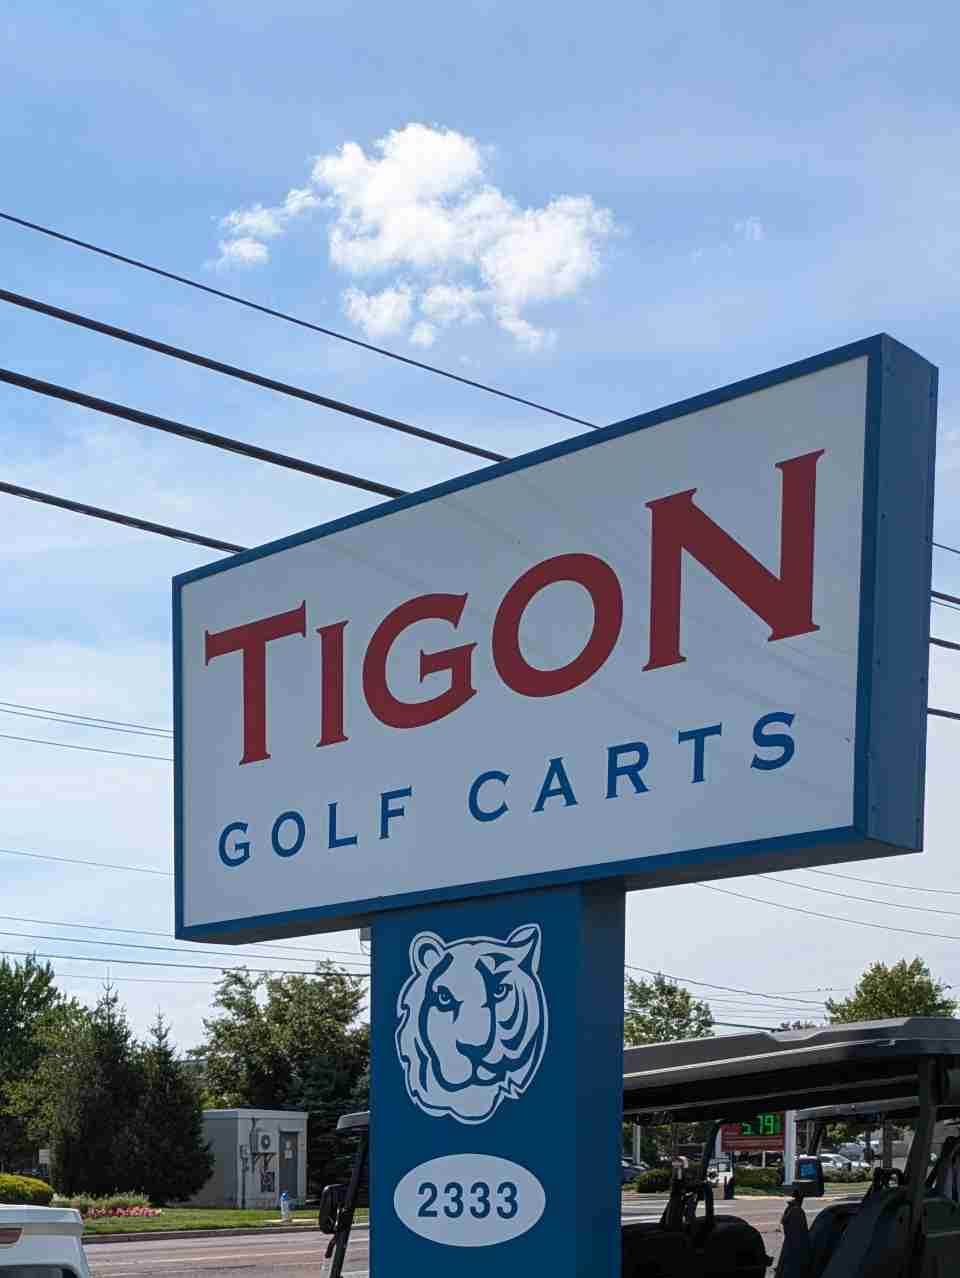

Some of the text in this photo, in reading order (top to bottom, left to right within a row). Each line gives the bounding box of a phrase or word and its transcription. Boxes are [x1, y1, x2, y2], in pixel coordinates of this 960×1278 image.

[205, 449, 825, 765] TIGON
[218, 712, 797, 867] GOLF CARTS
[416, 1181, 519, 1220] 2333
